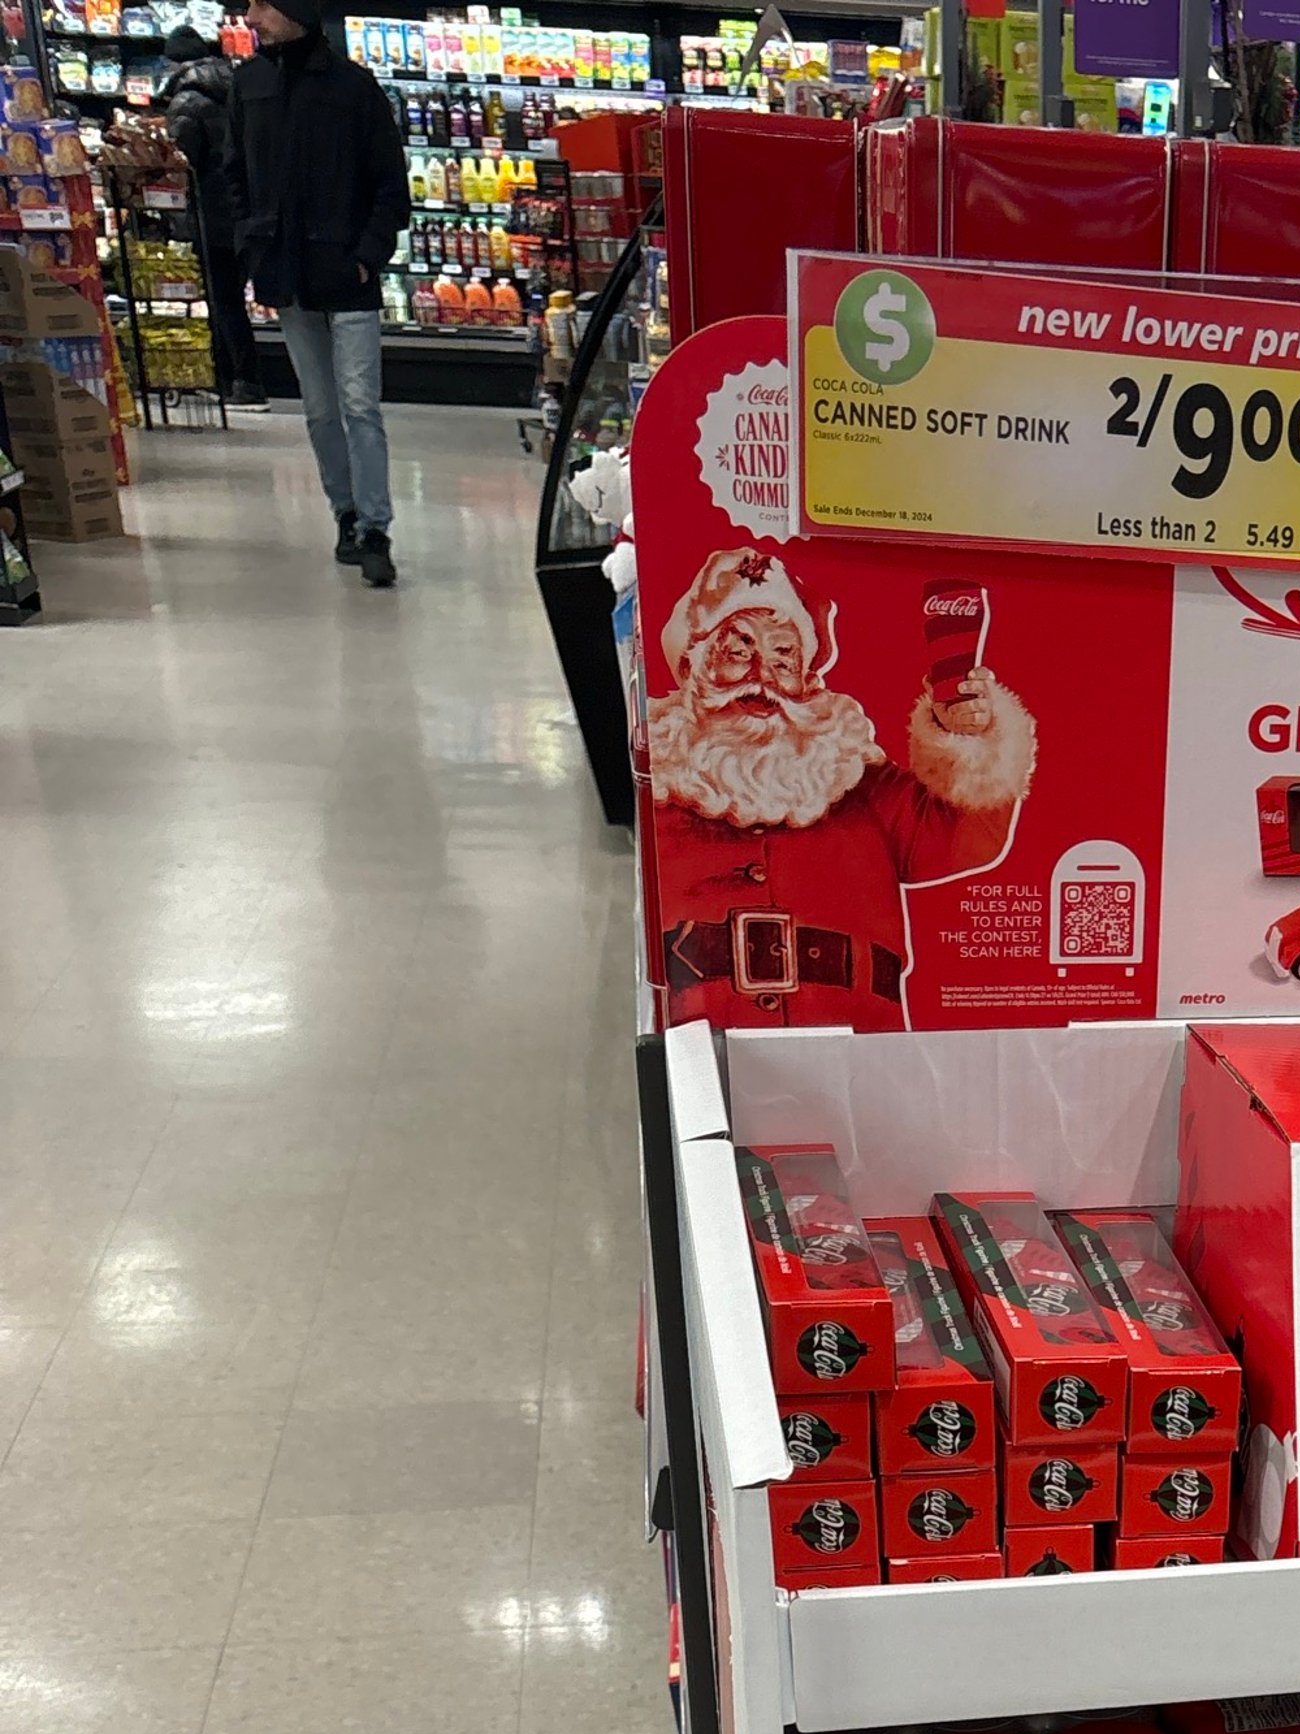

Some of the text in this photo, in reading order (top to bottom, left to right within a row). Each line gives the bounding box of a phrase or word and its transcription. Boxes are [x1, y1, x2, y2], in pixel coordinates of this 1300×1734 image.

[1018, 300, 1110, 342] new
[1122, 307, 1241, 353] lower
[813, 377, 885, 396] COCA COLA
[735, 411, 789, 442] CANA
[814, 398, 1071, 446] CANNED SOFT DRINK
[813, 429, 841, 442] Classic
[734, 443, 789, 480] KIND
[813, 504, 831, 514] Sale
[833, 505, 853, 517] Ends
[855, 507, 896, 520] December
[912, 511, 933, 524] 2024
[1097, 511, 1217, 544] Less than 2
[1246, 523, 1294, 551] 5.49
[923, 594, 981, 617] Coca-Cola
[1006, 885, 1043, 898] FULL
[959, 900, 1043, 913] RULES AND
[970, 916, 1043, 928] TO ENTER
[939, 931, 1043, 946] THE CONTEST,
[958, 946, 1043, 959] SCAN HERE
[1179, 991, 1226, 1006] metro
